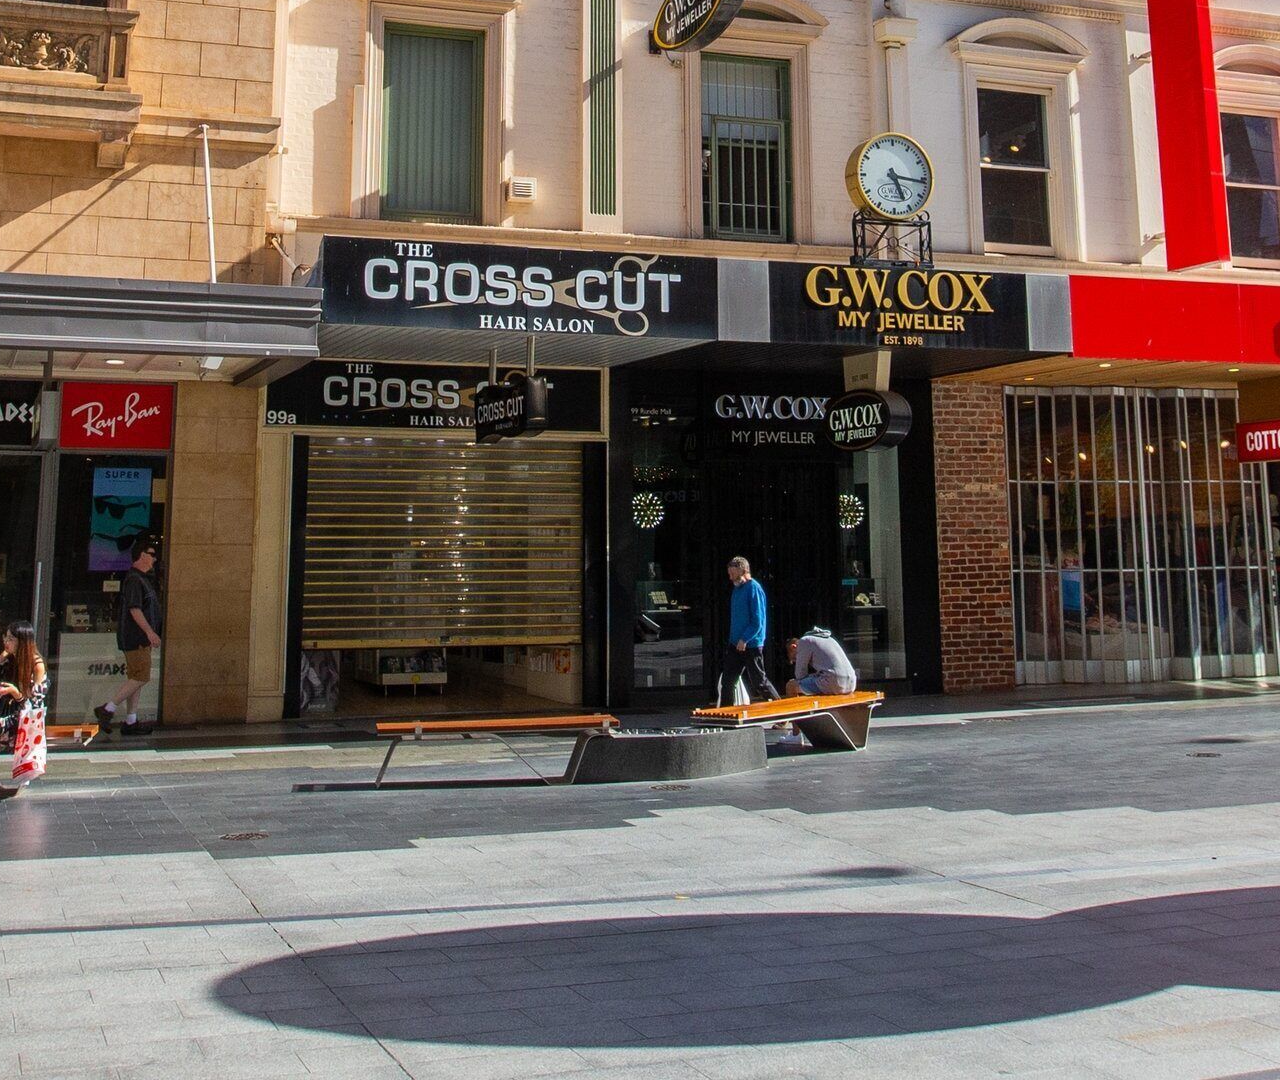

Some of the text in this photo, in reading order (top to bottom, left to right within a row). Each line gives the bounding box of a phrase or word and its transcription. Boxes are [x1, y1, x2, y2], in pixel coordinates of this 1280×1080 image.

[395, 242, 434, 258] THE
[363, 257, 682, 314] CROSS CUT
[479, 314, 595, 334] HAIR SALON
[838, 310, 966, 332] MY JEWELLER
[884, 335, 924, 347] EST. 1898
[345, 363, 374, 375] THE
[323, 375, 461, 410] CROSS
[267, 409, 297, 425] 99a
[477, 395, 525, 424] CROSS CUT
[631, 407, 673, 416] 99 Rundle Mall
[410, 415, 476, 428] HAIR SAL
[731, 430, 815, 446] MY JEWELLER
[834, 426, 877, 443] MY JEWELLER
[105, 470, 141, 480] SUPER
[88, 663, 129, 677] SHADE
